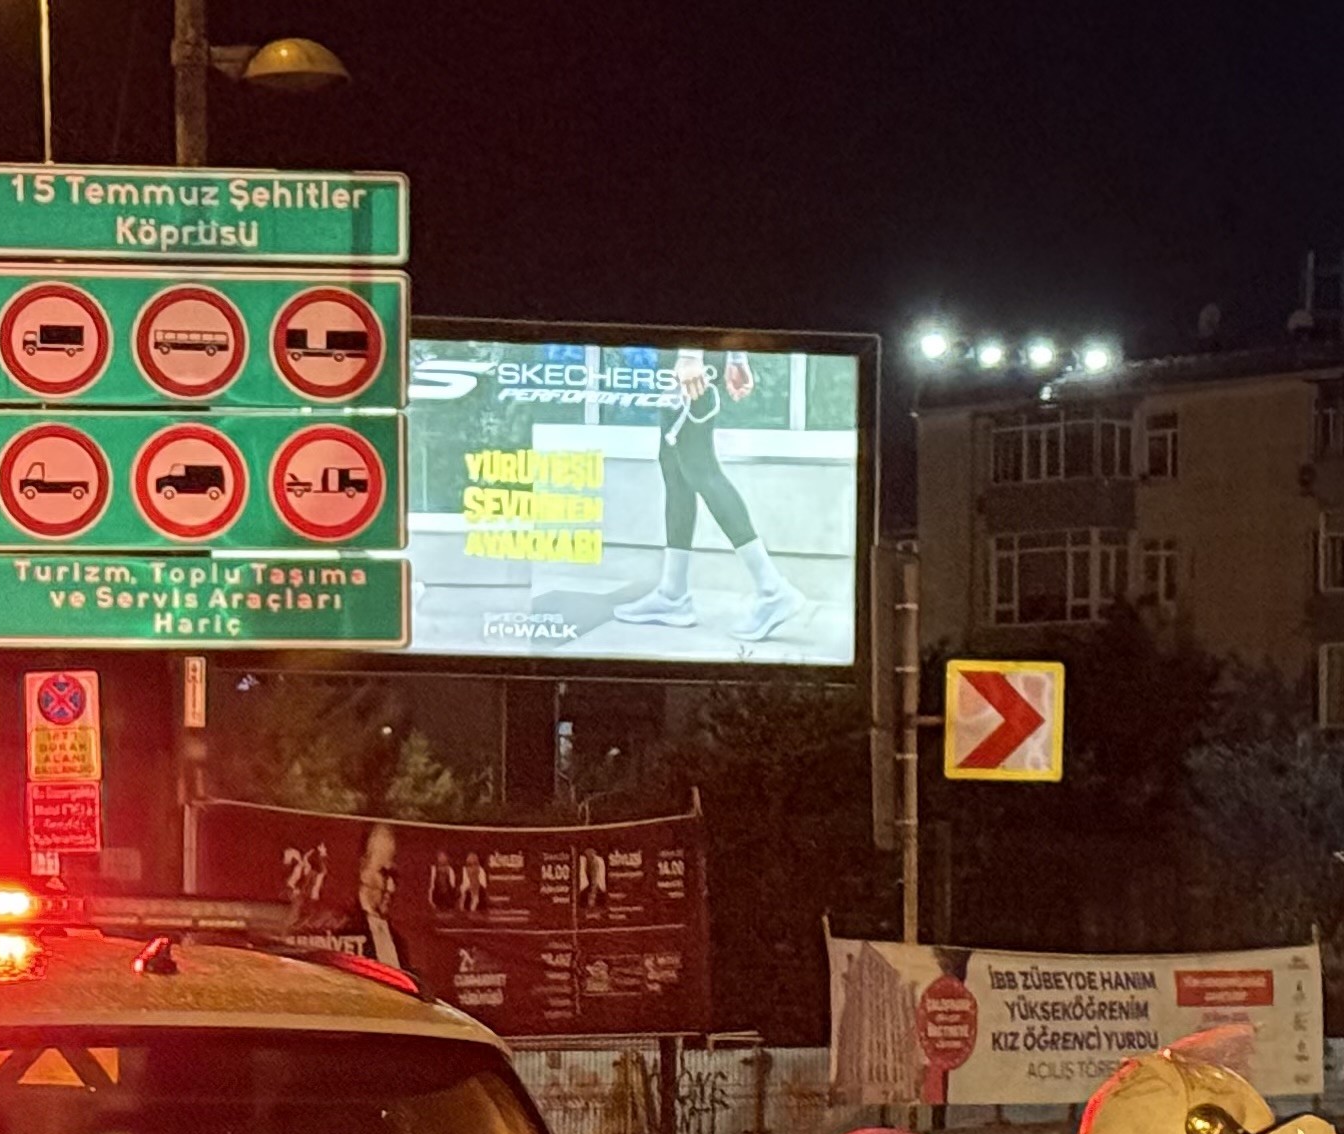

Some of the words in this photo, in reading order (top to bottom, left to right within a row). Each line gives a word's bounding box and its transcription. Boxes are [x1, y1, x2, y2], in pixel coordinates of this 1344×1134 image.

[12, 175, 55, 204] 15
[66, 175, 219, 207] Temmuz
[228, 178, 367, 212] Şehitler
[116, 216, 259, 252] Köprüsü
[498, 363, 679, 391] SKECHERS
[150, 562, 241, 588] Toplu
[253, 563, 367, 588] Taşıma
[51, 590, 86, 608] ve
[96, 587, 197, 609] Servis
[209, 588, 342, 613] Araçları
[154, 613, 242, 637] Hariç
[988, 964, 1018, 990] İBB
[1019, 965, 1099, 990] ZÜBEYDE
[1101, 970, 1157, 990] HANIM
[1005, 994, 1150, 1021] YÜKSEKÖĞRENİM
[991, 1031, 1020, 1051] KIZ
[1023, 1024, 1101, 1051] ÖĞRENCİ
[1103, 1030, 1159, 1050] YURDU
